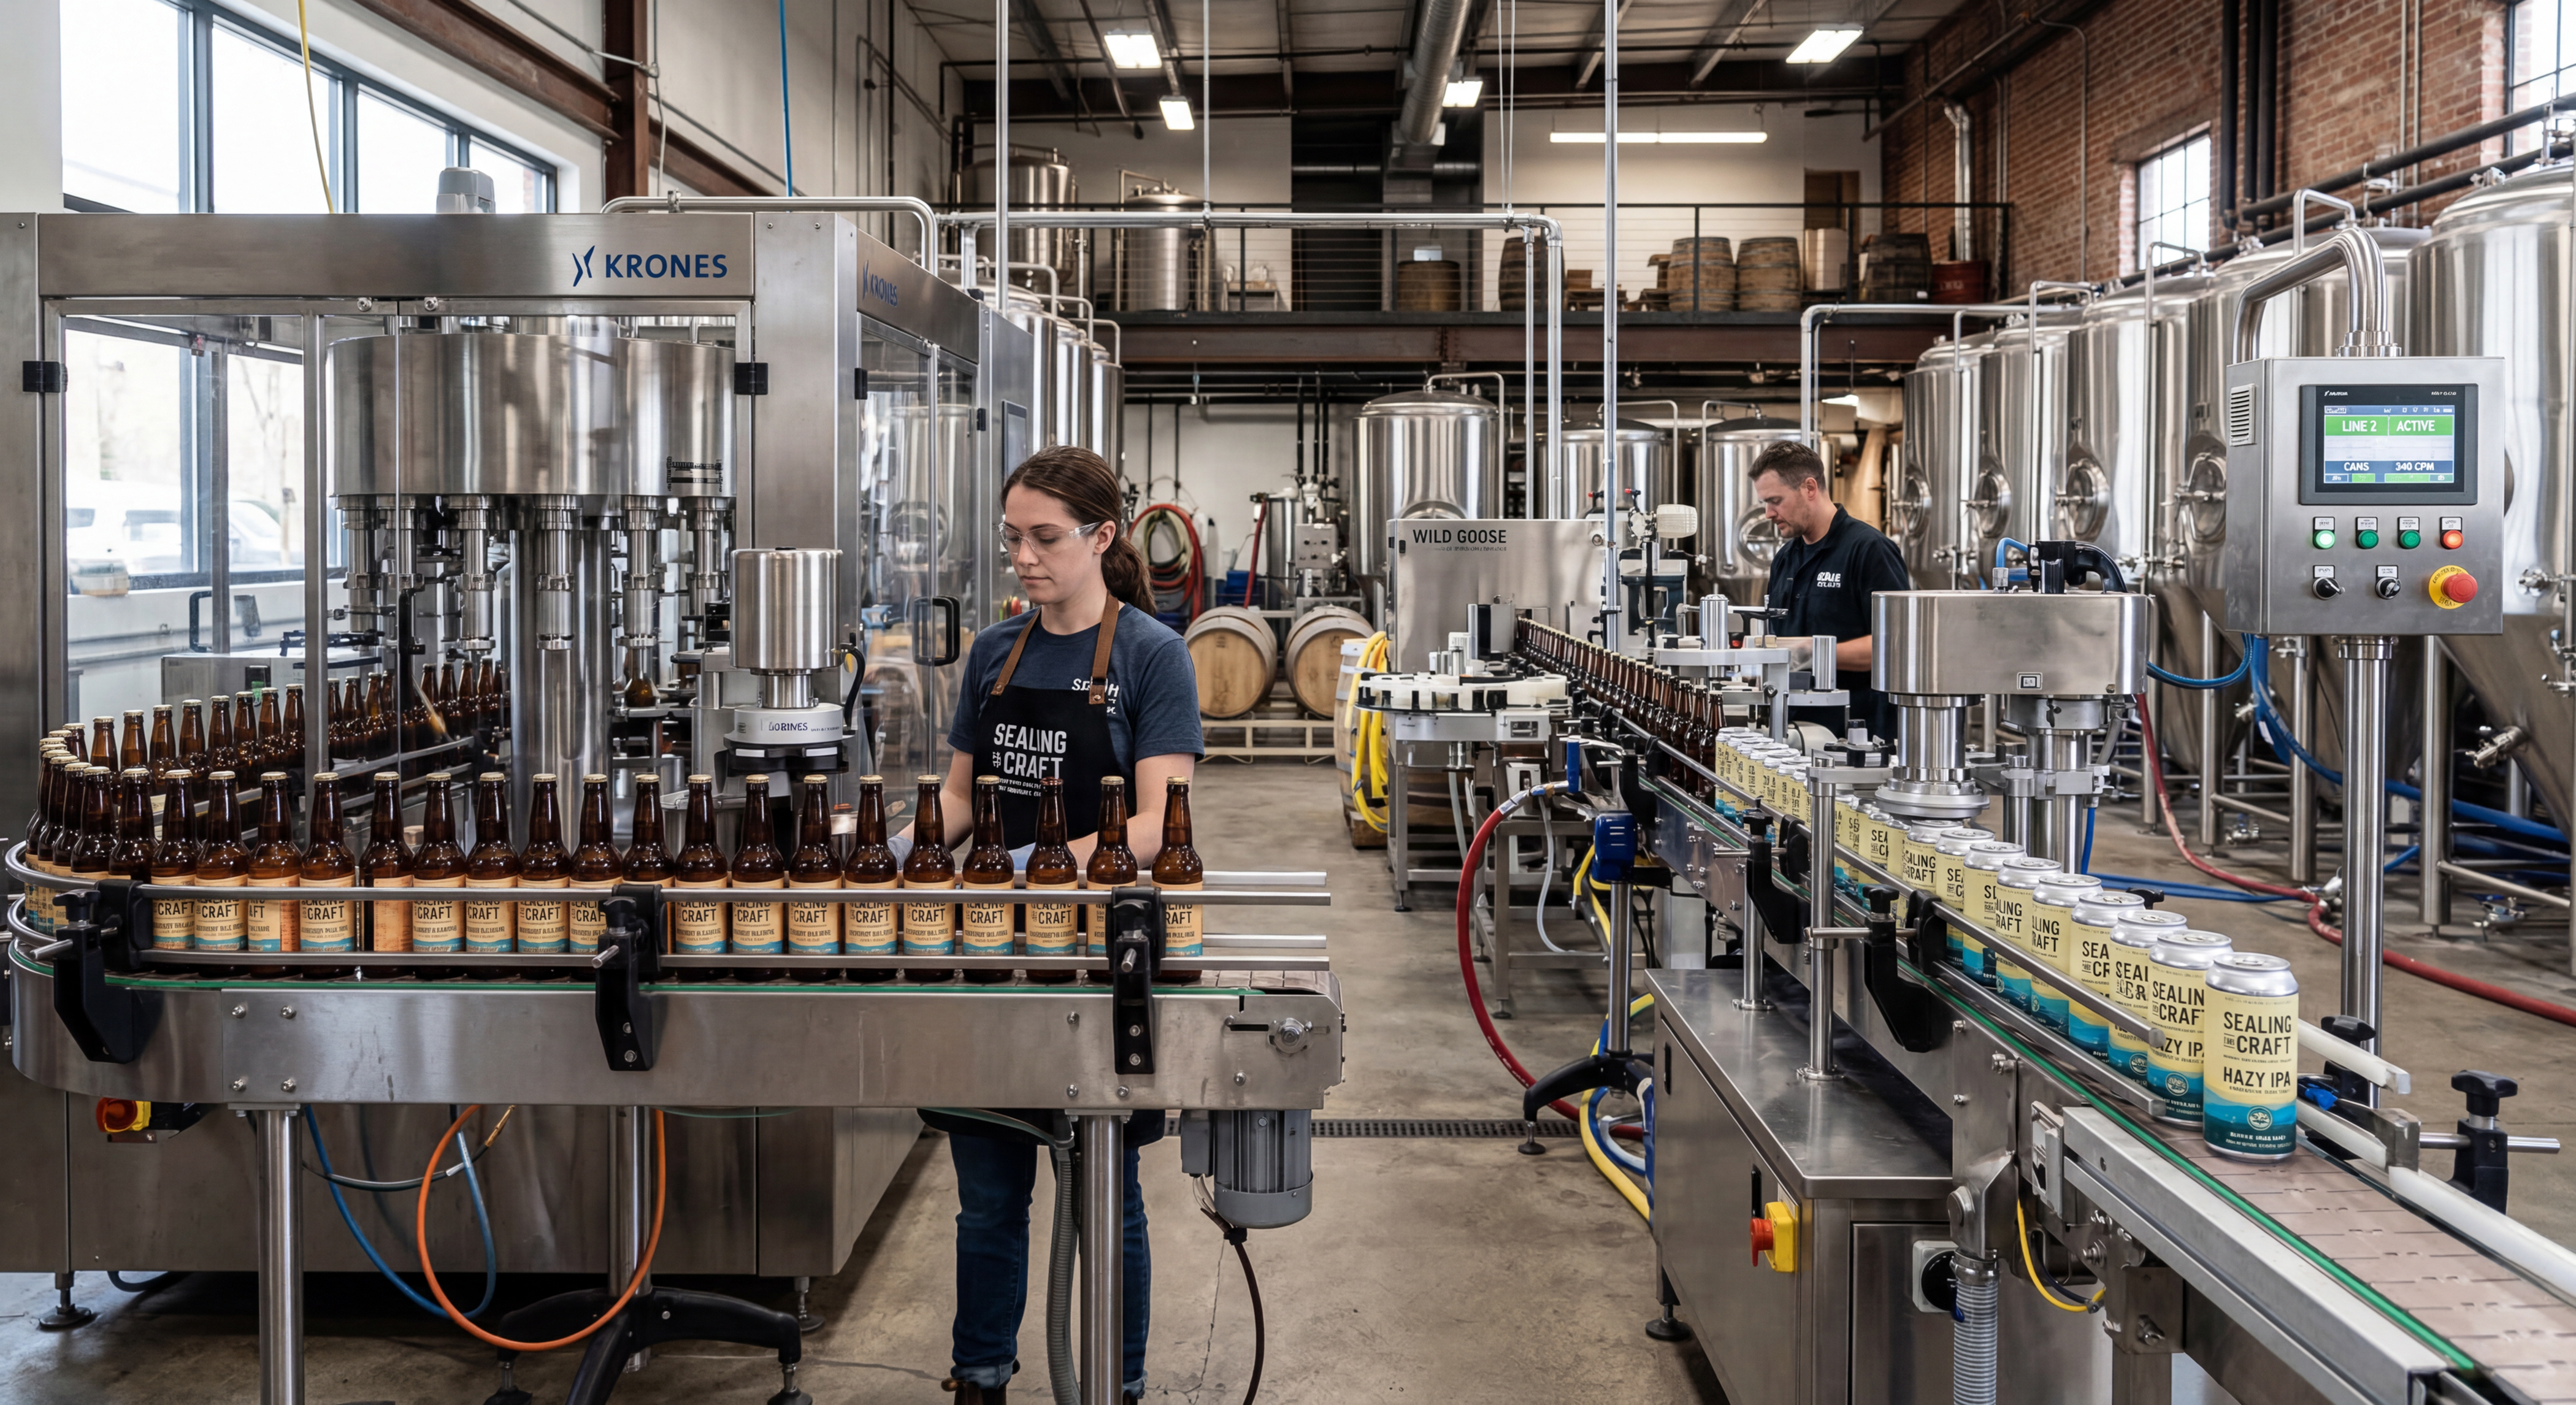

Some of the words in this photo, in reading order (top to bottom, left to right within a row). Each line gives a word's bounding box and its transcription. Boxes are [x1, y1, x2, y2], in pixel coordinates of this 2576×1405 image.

[605, 254, 728, 278] KRONES
[2342, 420, 2367, 432] LINE
[2370, 420, 2377, 432] 2
[2396, 419, 2436, 432] ACTIVE
[2344, 462, 2369, 471] CANS
[2395, 462, 2412, 471] 340
[2414, 462, 2434, 471] CPM
[1413, 529, 1452, 543] WILD
[1457, 529, 1506, 543] GOOSE
[994, 723, 1067, 754] SEALING
[1003, 751, 1064, 779] CRAFT
[202, 903, 239, 918] CRAFT
[418, 906, 452, 919] CRAFT
[468, 906, 500, 920] CRAFT
[526, 906, 561, 921] CRAFT
[681, 908, 716, 922] CRAFT
[737, 909, 770, 922] CRAFT
[794, 909, 827, 923] CRAFT
[856, 909, 890, 923] CRAFT
[911, 908, 945, 922] CRAFT
[971, 910, 1003, 924] CRAFT
[1038, 910, 1072, 924] CRAFT
[2153, 981, 2204, 1006] SEALIN
[2160, 1003, 2204, 1025] CRAF
[2223, 1011, 2291, 1034] SEALING
[2236, 1035, 2291, 1055] CRAFT
[2223, 1066, 2265, 1087] HAZY
[2271, 1071, 2291, 1088] IPA
